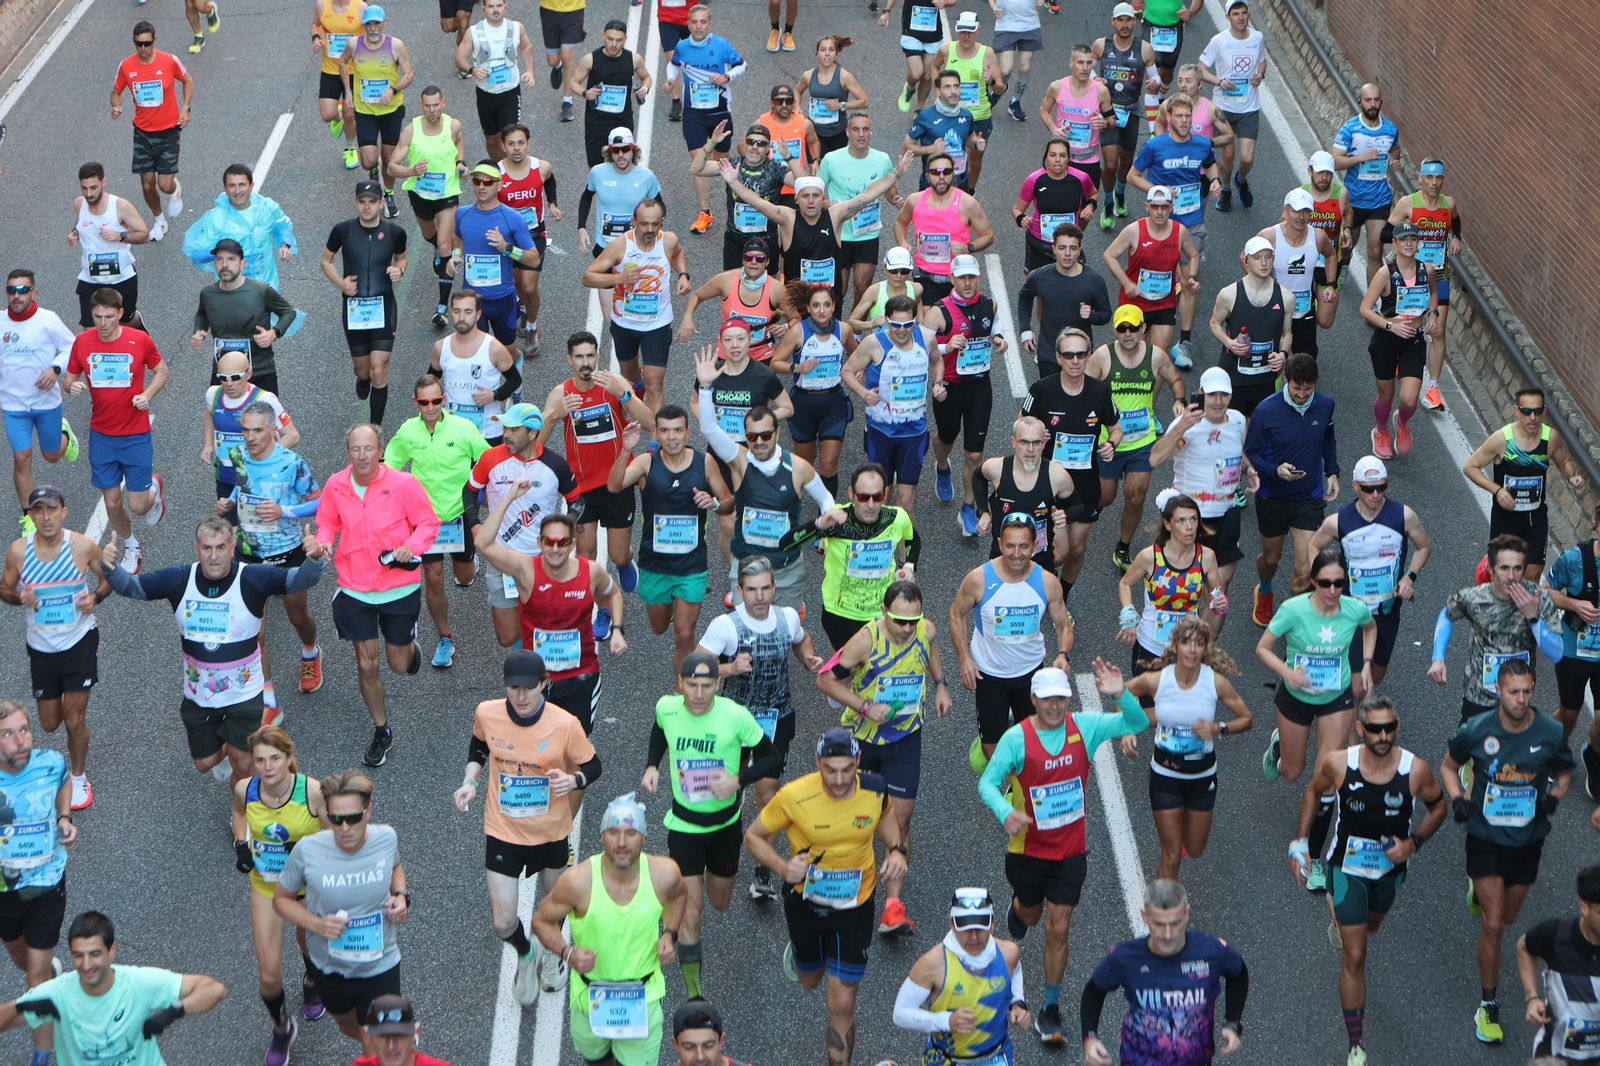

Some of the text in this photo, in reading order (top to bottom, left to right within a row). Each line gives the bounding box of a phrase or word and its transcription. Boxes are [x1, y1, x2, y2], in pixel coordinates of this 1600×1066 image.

[1062, 106, 1082, 114] SUPER
[1162, 156, 1188, 168] emf
[508, 189, 536, 201] PERÚ
[1417, 217, 1446, 228] Gorras
[716, 394, 751, 402] CHICAGO
[459, 404, 480, 412] ZURIC
[583, 408, 606, 417] ZURICH
[867, 543, 888, 551] ZURICH
[45, 598, 69, 606] ZURICH
[199, 602, 227, 610] ZURICH
[1306, 644, 1345, 654] SAYSKY
[895, 677, 918, 685] ZURICH
[676, 737, 716, 754] ELEVATE
[494, 756, 518, 766] Maratón
[1045, 754, 1072, 770] DATO
[1049, 783, 1075, 795] ZURICH
[17, 826, 45, 834] ZURICH
[322, 868, 384, 887] MATTIAS
[348, 918, 376, 927] ZURICH
[1136, 988, 1206, 1010] VII TRAIL
